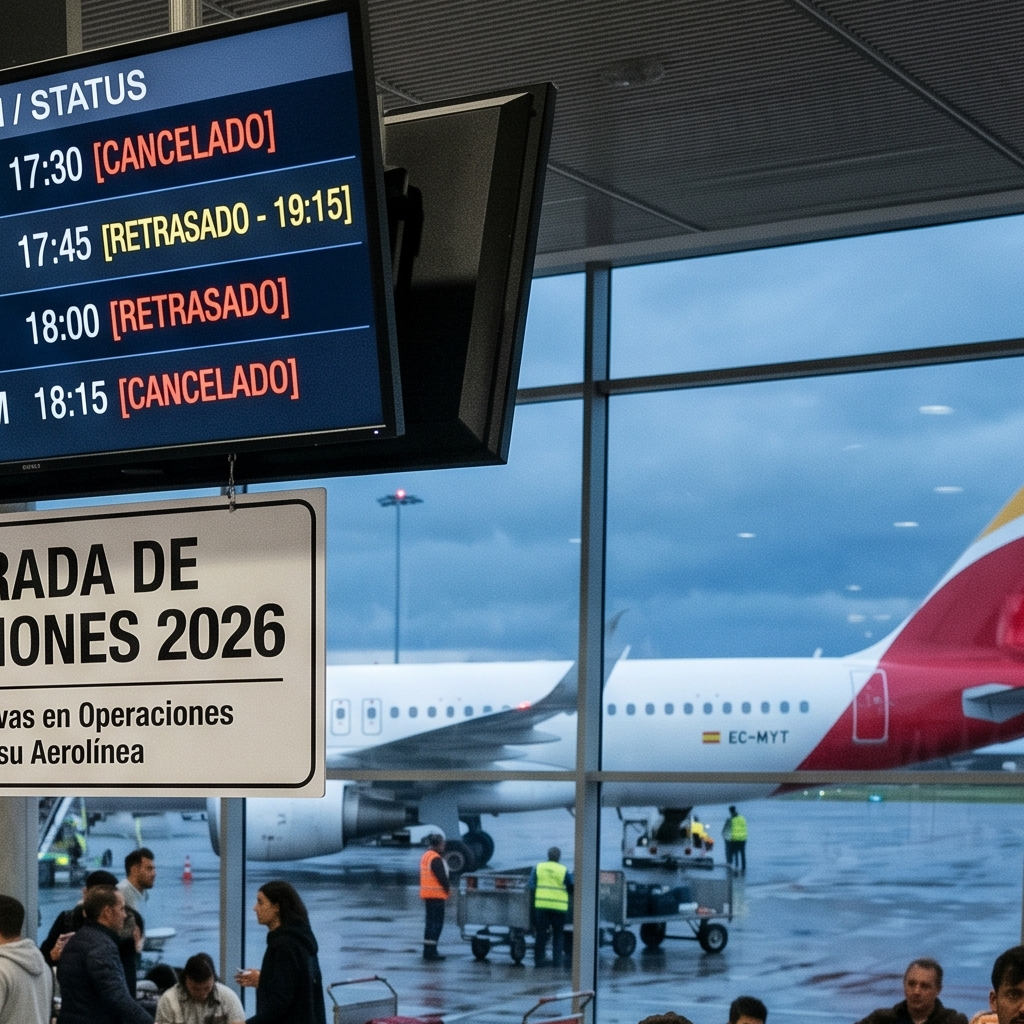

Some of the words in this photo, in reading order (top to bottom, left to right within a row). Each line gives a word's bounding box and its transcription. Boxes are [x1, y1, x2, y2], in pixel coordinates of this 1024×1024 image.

[13, 93, 22, 125] /
[30, 69, 147, 121] STATUS
[8, 147, 83, 191] 17:30
[92, 109, 276, 184] [CANCELADO]
[17, 226, 92, 268] 17:45
[101, 202, 250, 262] [RETRASADO
[256, 214, 267, 222] -
[274, 185, 351, 232] 19:15]
[25, 304, 100, 345] 18:00
[109, 277, 288, 341] [RETRASADO]
[34, 380, 108, 421] 18:15
[118, 358, 299, 418] [CANCELADO]
[133, 537, 199, 593] DE
[157, 604, 285, 661] 2026
[43, 708, 71, 728] en
[79, 701, 234, 731] Operaciones
[728, 730, 789, 744] EC-MYT
[31, 739, 144, 765] Aerolínea
